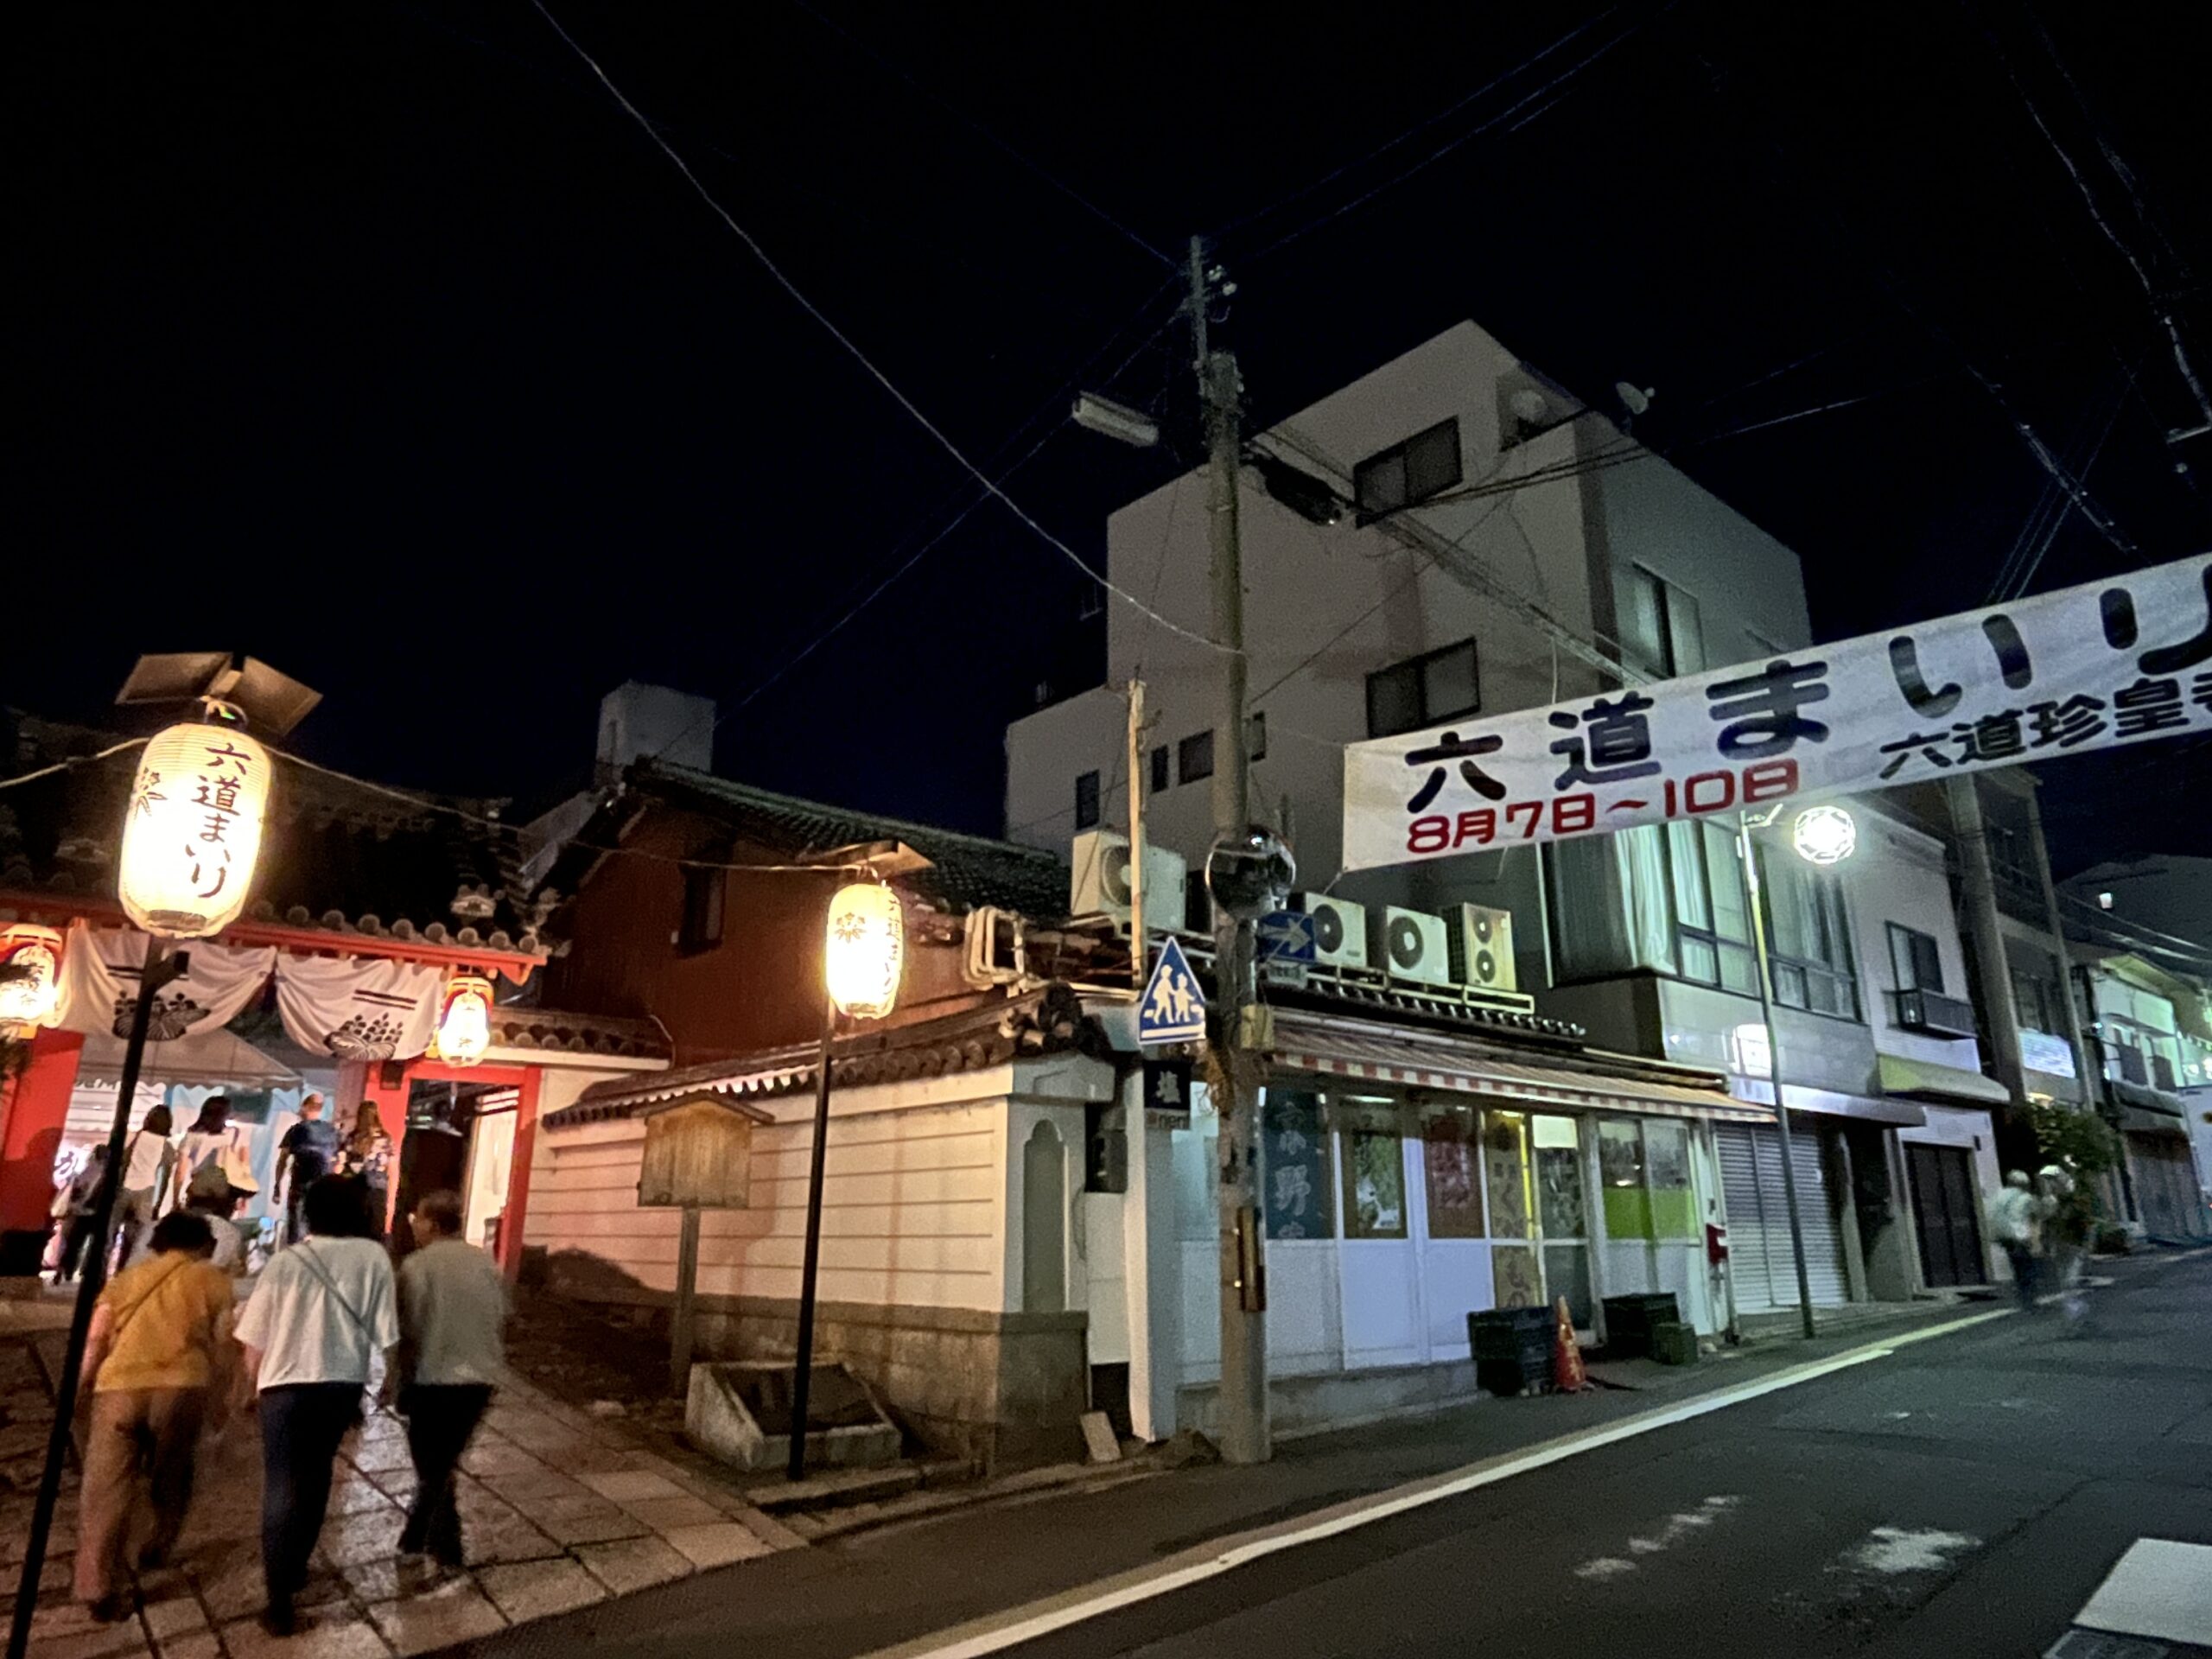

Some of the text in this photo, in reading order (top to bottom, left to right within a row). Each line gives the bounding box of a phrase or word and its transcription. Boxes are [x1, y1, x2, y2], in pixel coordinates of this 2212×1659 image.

[1404, 563, 2212, 814] 六道まいり
[185, 742, 251, 899] 六道まいり
